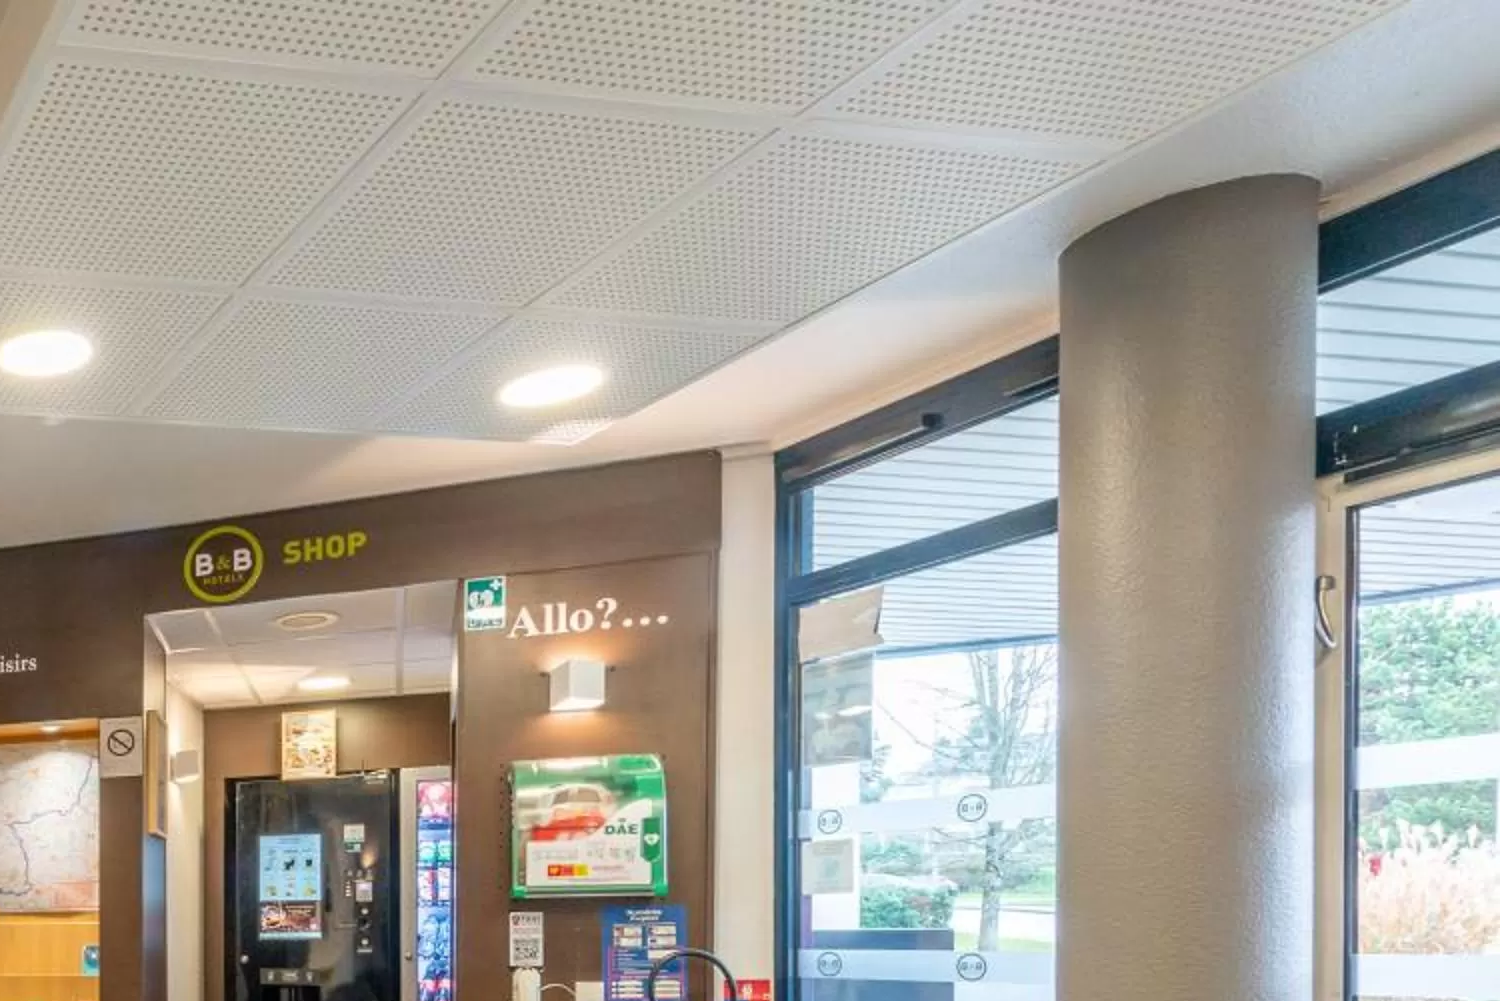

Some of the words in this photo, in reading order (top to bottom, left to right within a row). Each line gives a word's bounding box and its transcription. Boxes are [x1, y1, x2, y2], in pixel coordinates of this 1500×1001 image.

[194, 548, 253, 577] B&B
[283, 531, 367, 565] SHOP
[506, 597, 669, 639] Allo?...
[604, 823, 640, 835] DAE
